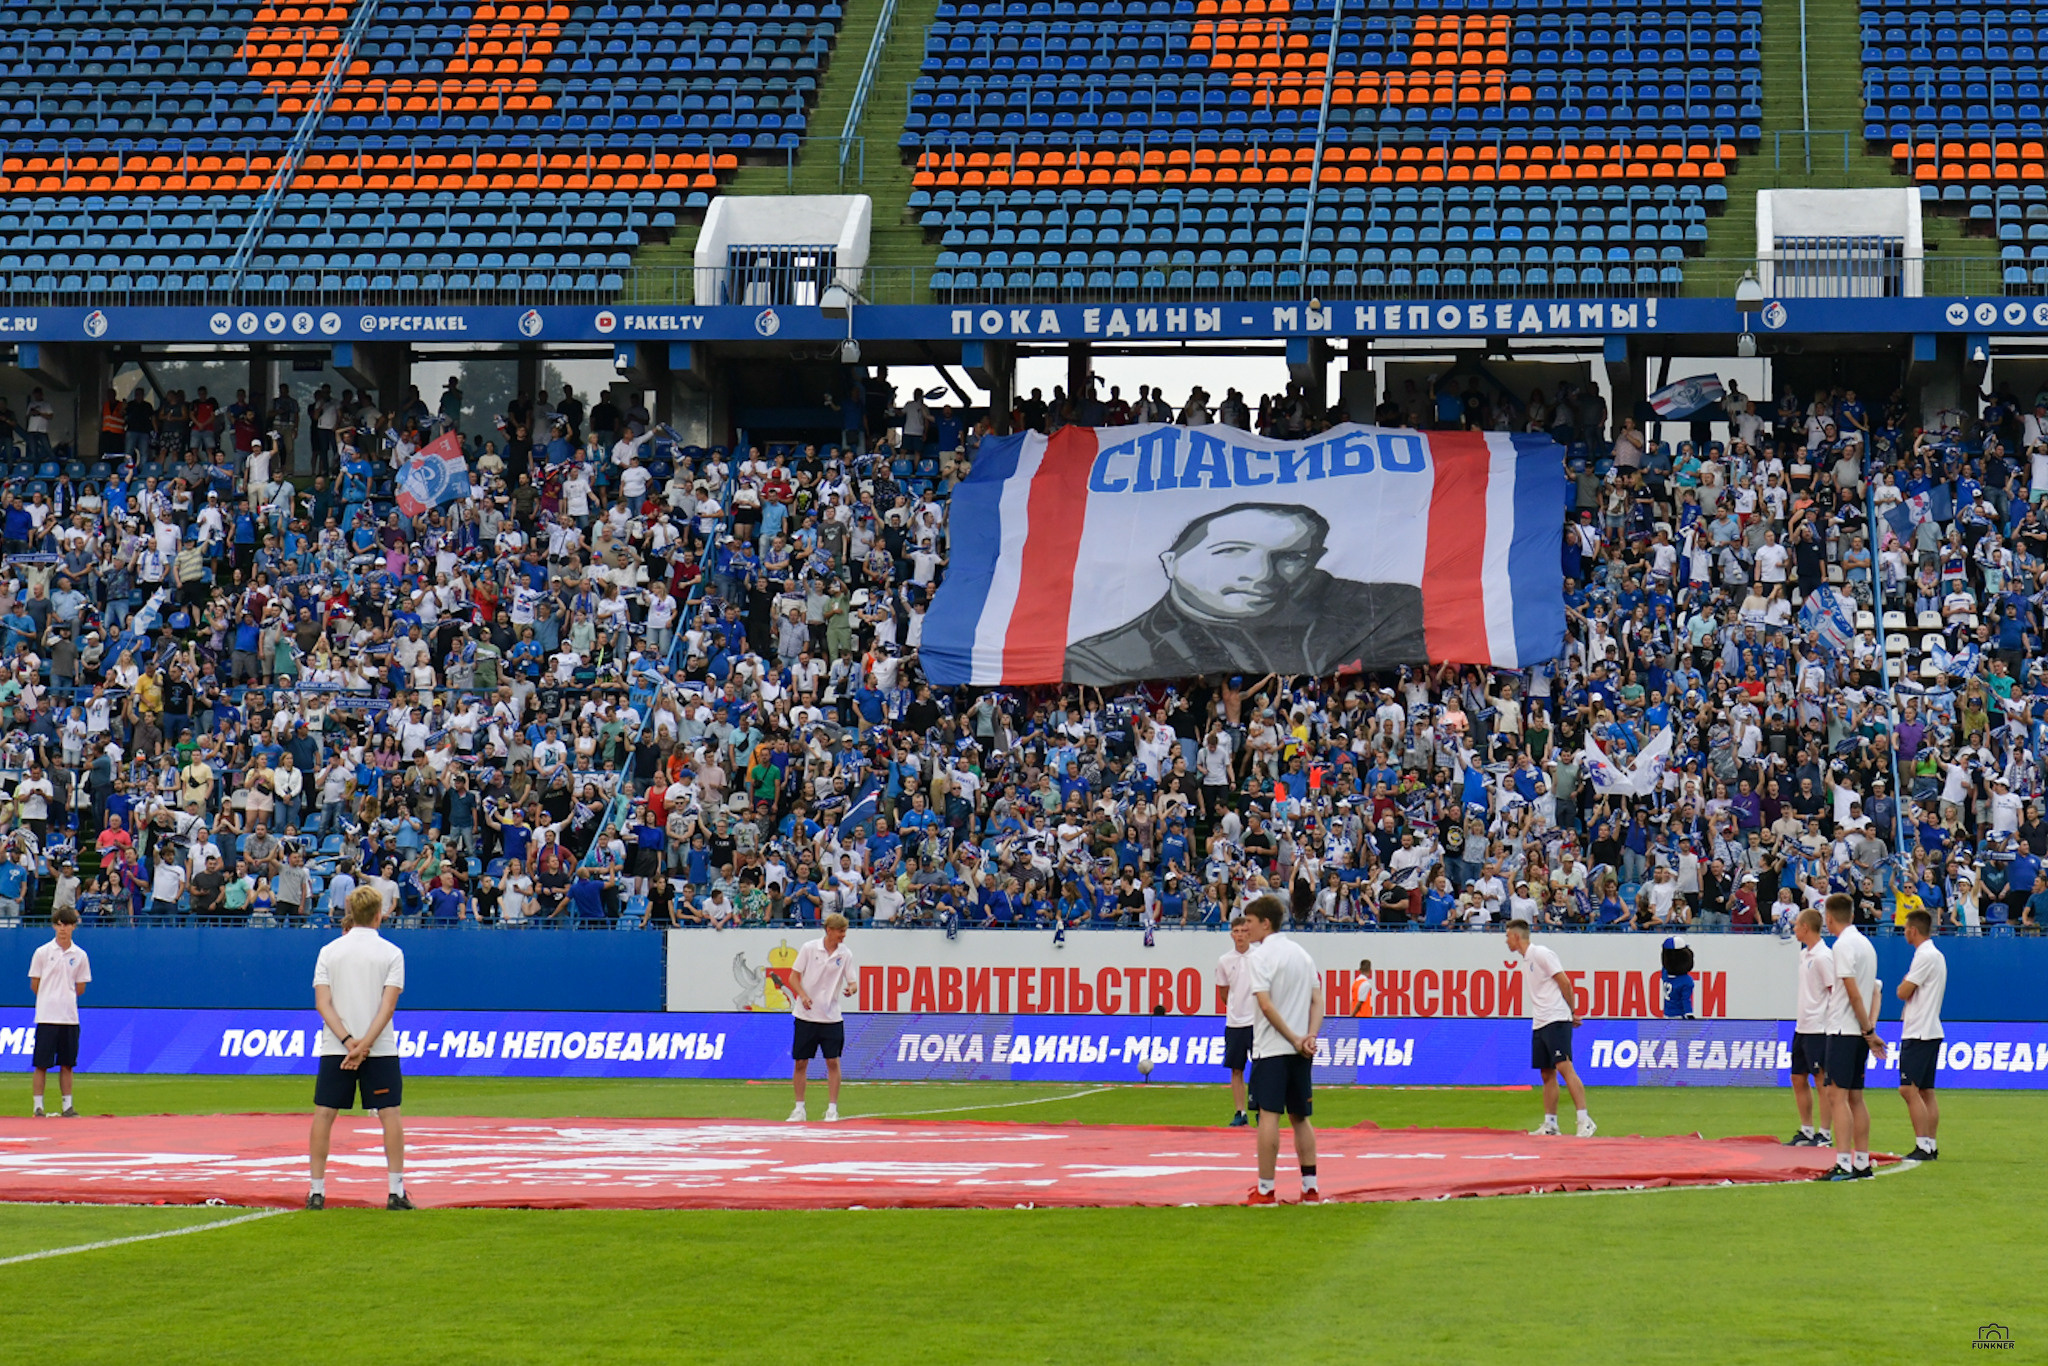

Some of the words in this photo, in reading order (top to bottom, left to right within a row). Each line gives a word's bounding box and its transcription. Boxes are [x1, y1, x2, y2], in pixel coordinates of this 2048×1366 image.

[359, 315, 468, 333] @PFCFAKEL
[623, 315, 705, 330] FAKELTV
[950, 309, 1061, 335] ПОКА
[1082, 307, 1222, 338] ЕДИНЫ
[1242, 316, 1254, 325] -
[1271, 304, 1333, 332] МЫ
[1354, 302, 1658, 336] НЕПОБЕДИМЫ!
[859, 966, 1202, 1016] ПРАВИТЕЛЬСТВО
[220, 1029, 306, 1058] ПОКА
[500, 1030, 727, 1062] НЕПОБЕДИМЫ
[896, 1033, 984, 1064] ПОКА
[1590, 1039, 1679, 1069] ПОКА
